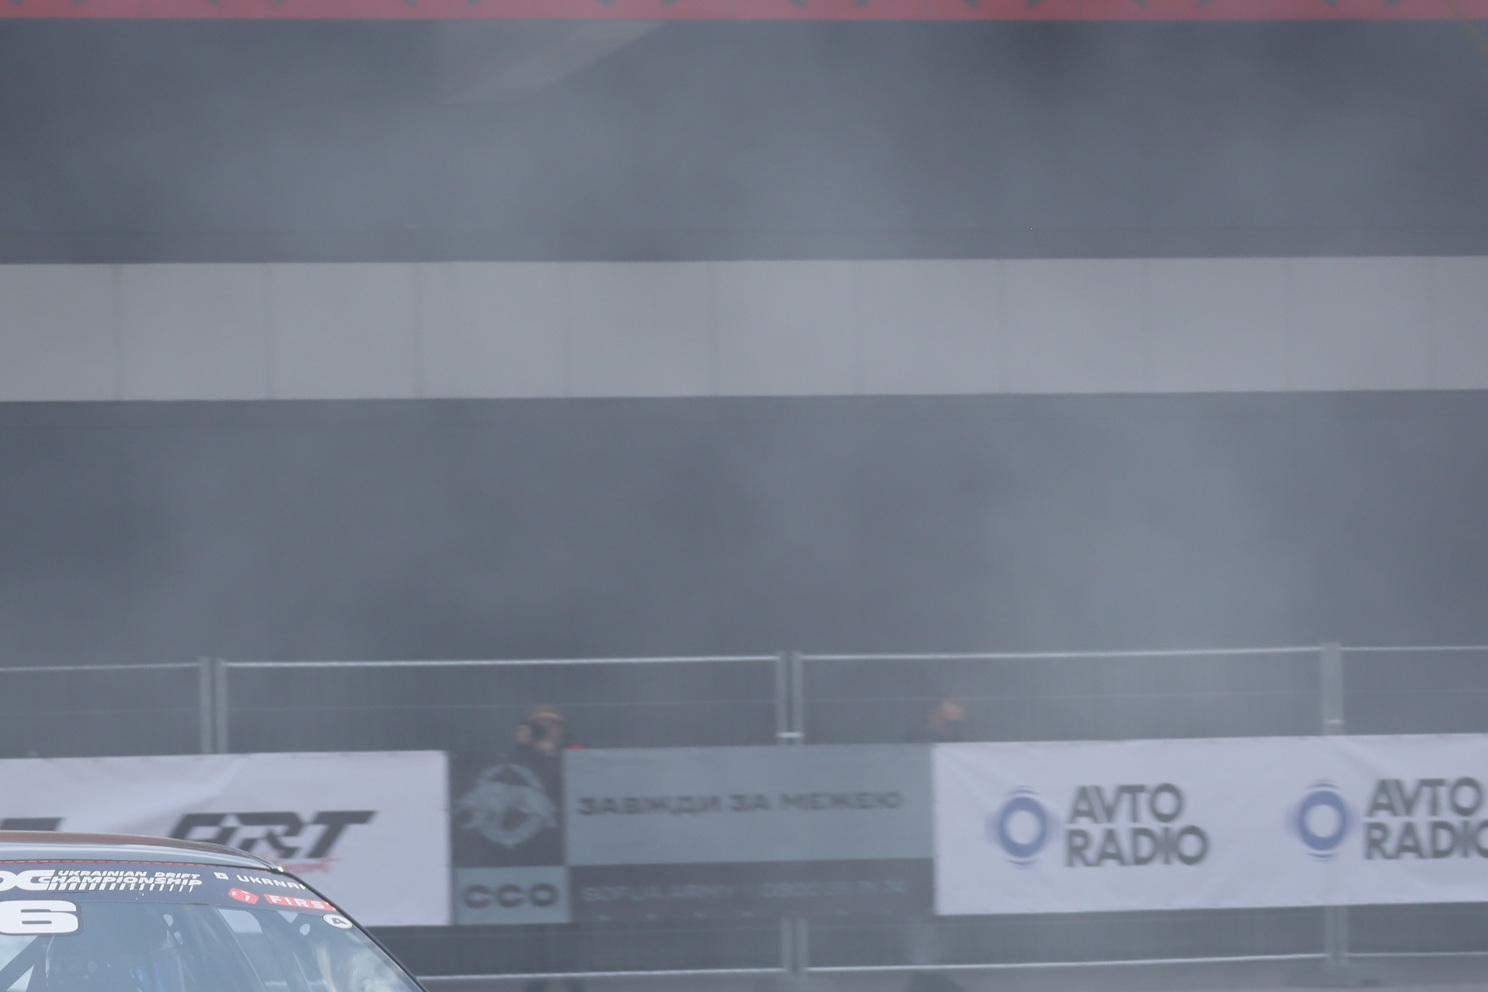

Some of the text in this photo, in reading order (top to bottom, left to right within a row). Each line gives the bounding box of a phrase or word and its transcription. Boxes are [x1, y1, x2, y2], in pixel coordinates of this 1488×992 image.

[1068, 783, 1184, 823] AVTO
[1367, 776, 1484, 817] AVTO
[1066, 825, 1209, 867] RADIO
[38, 876, 202, 885] CHAMPIONSHIP
